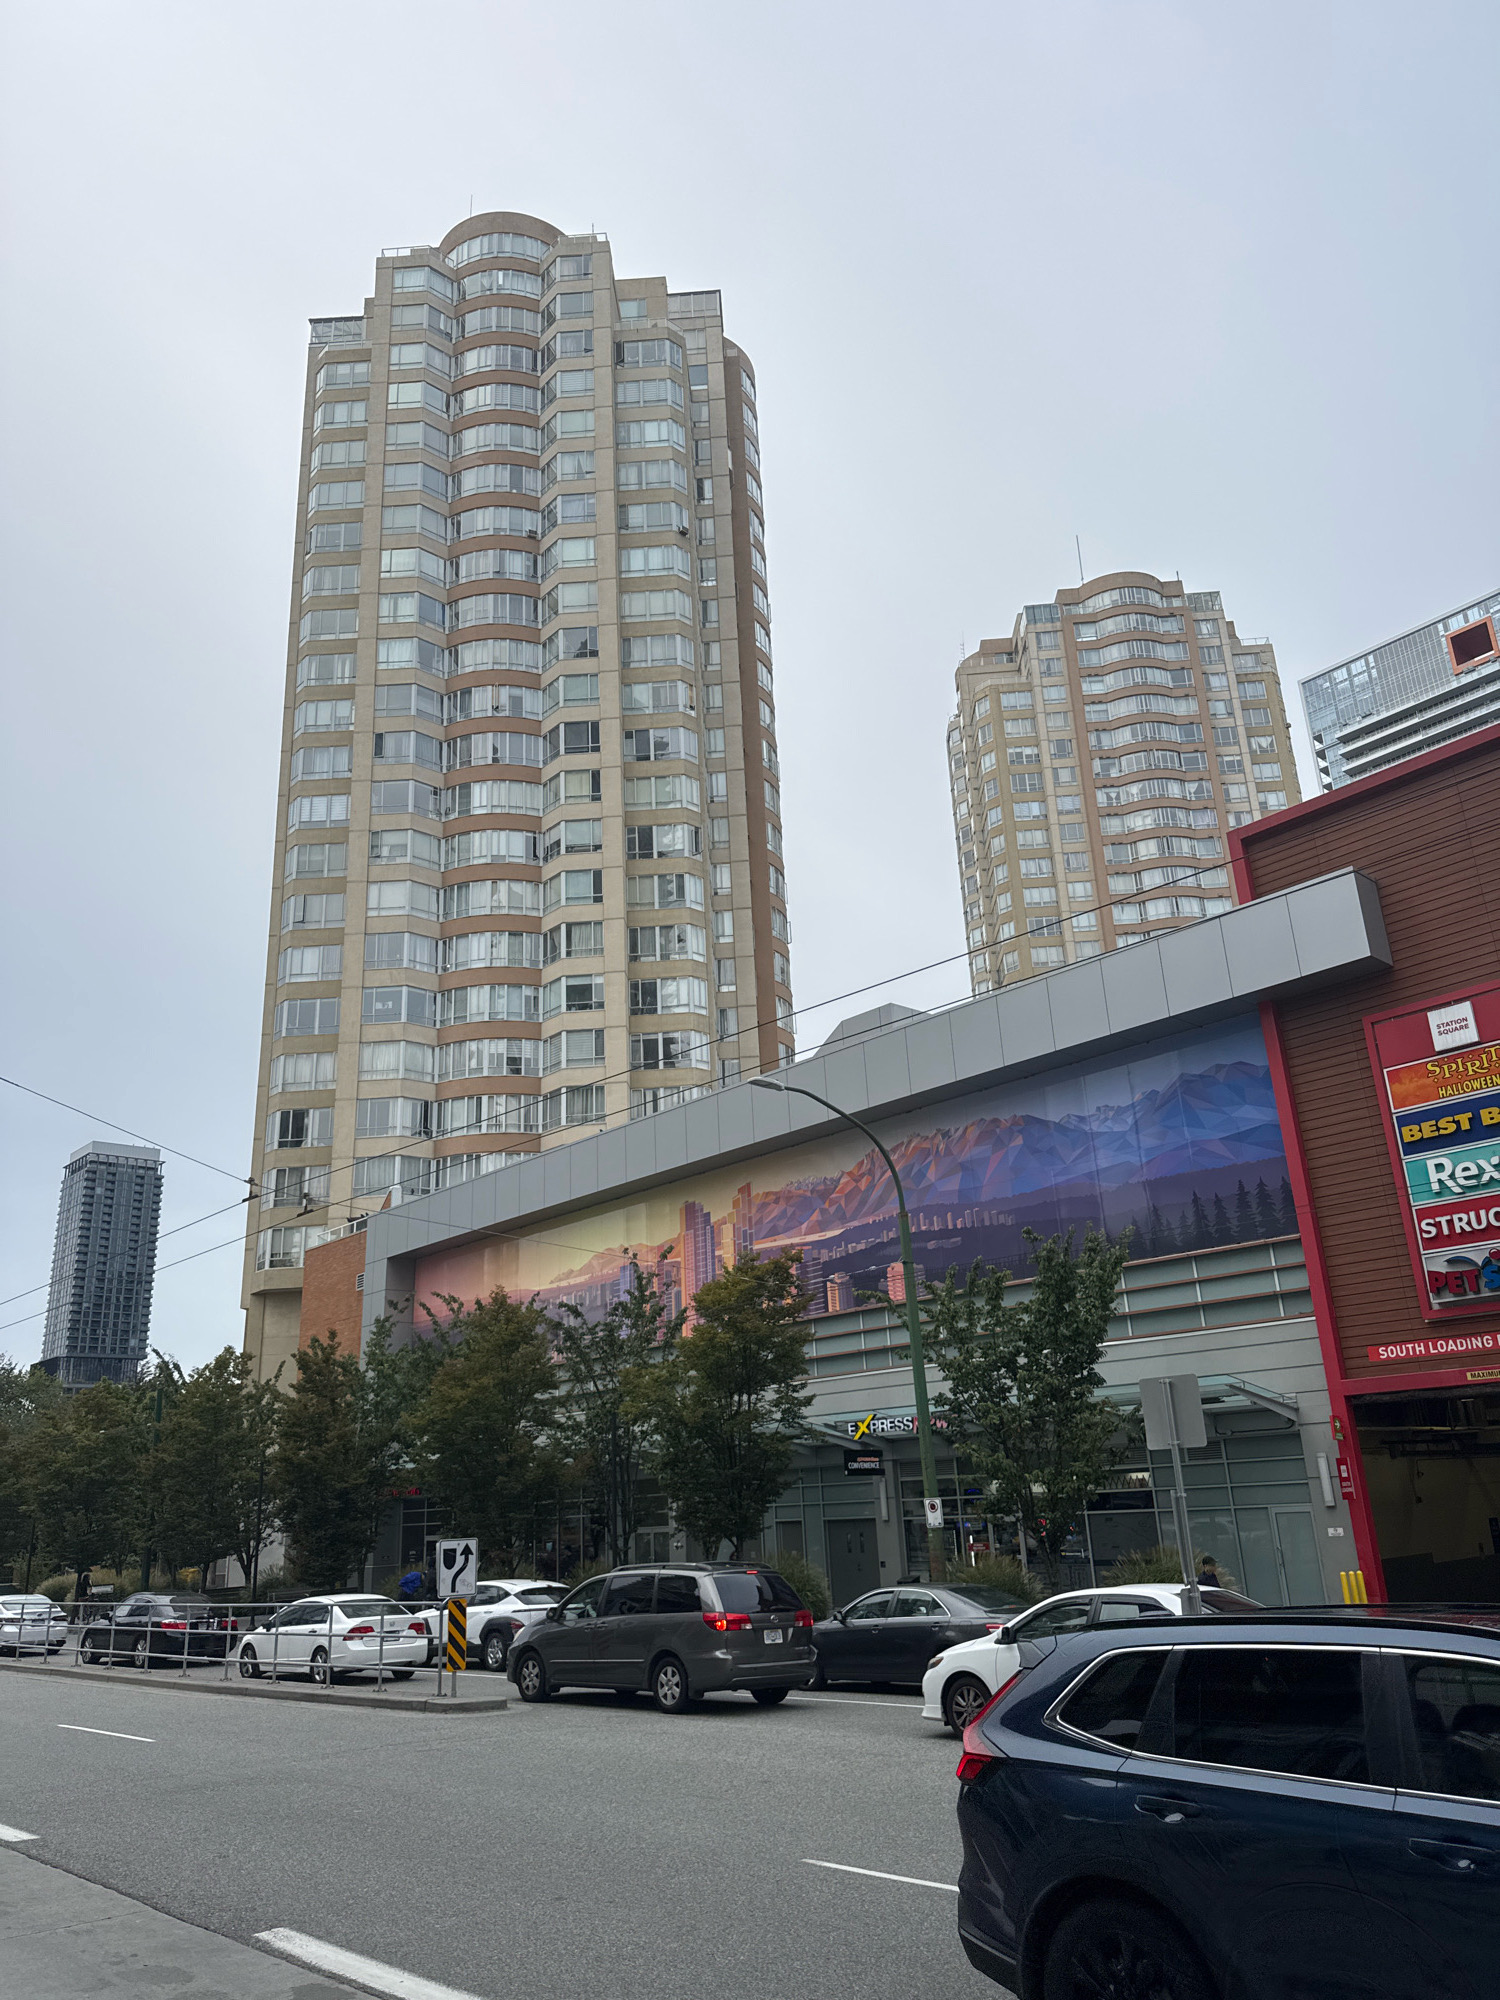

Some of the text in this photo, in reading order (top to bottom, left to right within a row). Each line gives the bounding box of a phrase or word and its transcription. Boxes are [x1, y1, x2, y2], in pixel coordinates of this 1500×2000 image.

[1436, 1016, 1469, 1030] STATION
[1437, 1023, 1470, 1036] SQUARE
[1426, 1045, 1500, 1079] SPIRIT
[1438, 1073, 1500, 1098] HALLOWEEN
[1401, 1107, 1500, 1143] BEST B
[1420, 1206, 1500, 1239] STRUC
[1378, 1343, 1426, 1359] SOUTH
[1428, 1335, 1494, 1354] LOADING
[1470, 1370, 1500, 1379] MAXIMU
[848, 1414, 913, 1440] EXPRESS
